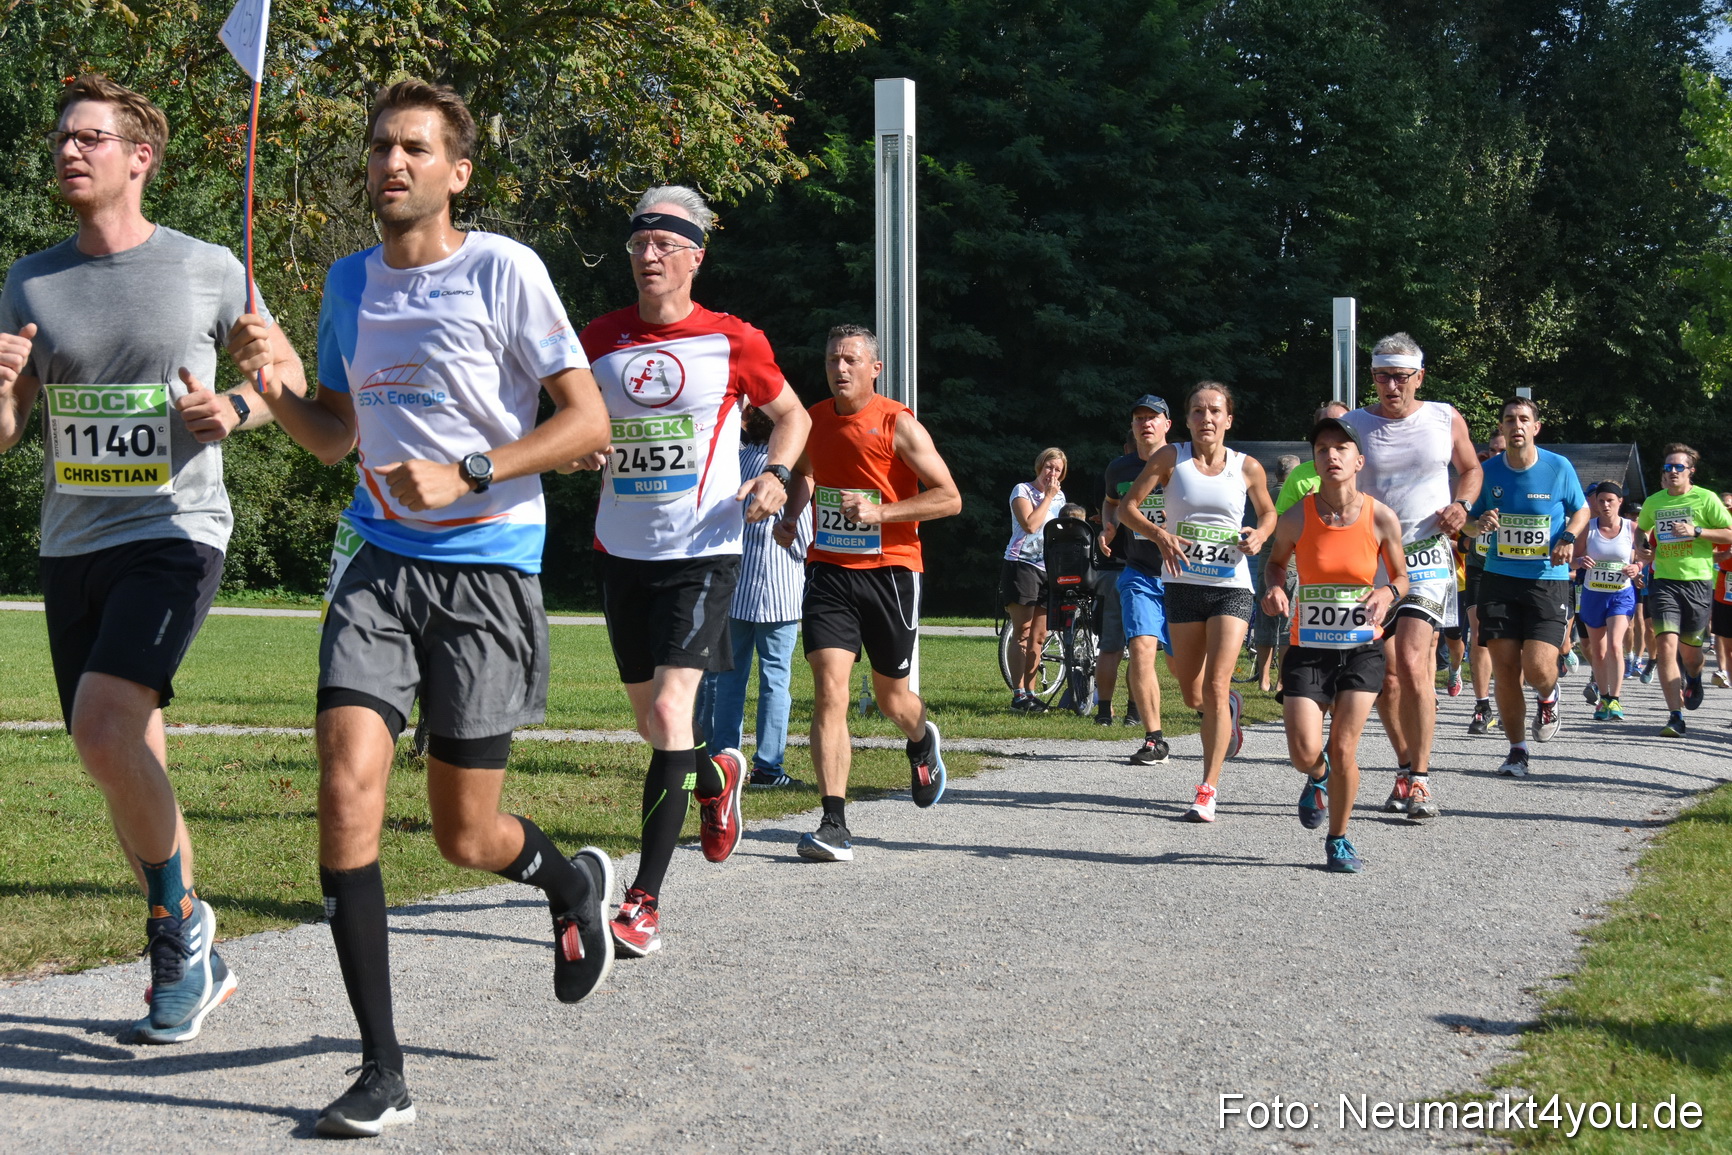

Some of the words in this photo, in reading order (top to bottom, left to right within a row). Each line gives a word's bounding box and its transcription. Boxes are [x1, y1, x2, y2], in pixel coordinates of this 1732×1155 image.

[55, 389, 158, 413] BOCK
[387, 389, 447, 407] Energie
[611, 418, 688, 440] BOCK
[64, 424, 156, 457] 1140
[616, 445, 686, 473] 2452
[63, 467, 158, 482] CHRISTIAN
[634, 480, 668, 492] RUDI
[1657, 508, 1688, 518] BOCK
[1501, 516, 1546, 527] BOCK
[826, 534, 866, 547] JÜRGEN
[1181, 524, 1234, 543] BOCK
[1504, 529, 1544, 544] 1189
[1183, 544, 1230, 563] 2434
[1660, 543, 1692, 551] PREMIUM
[1660, 550, 1694, 558] REISEN
[1406, 549, 1442, 567] 008
[1188, 564, 1219, 575] KARIN
[1594, 571, 1622, 582] 1157
[1304, 586, 1370, 601] BOCK
[1307, 605, 1367, 627] 2076
[1315, 631, 1358, 642] NICOLE
